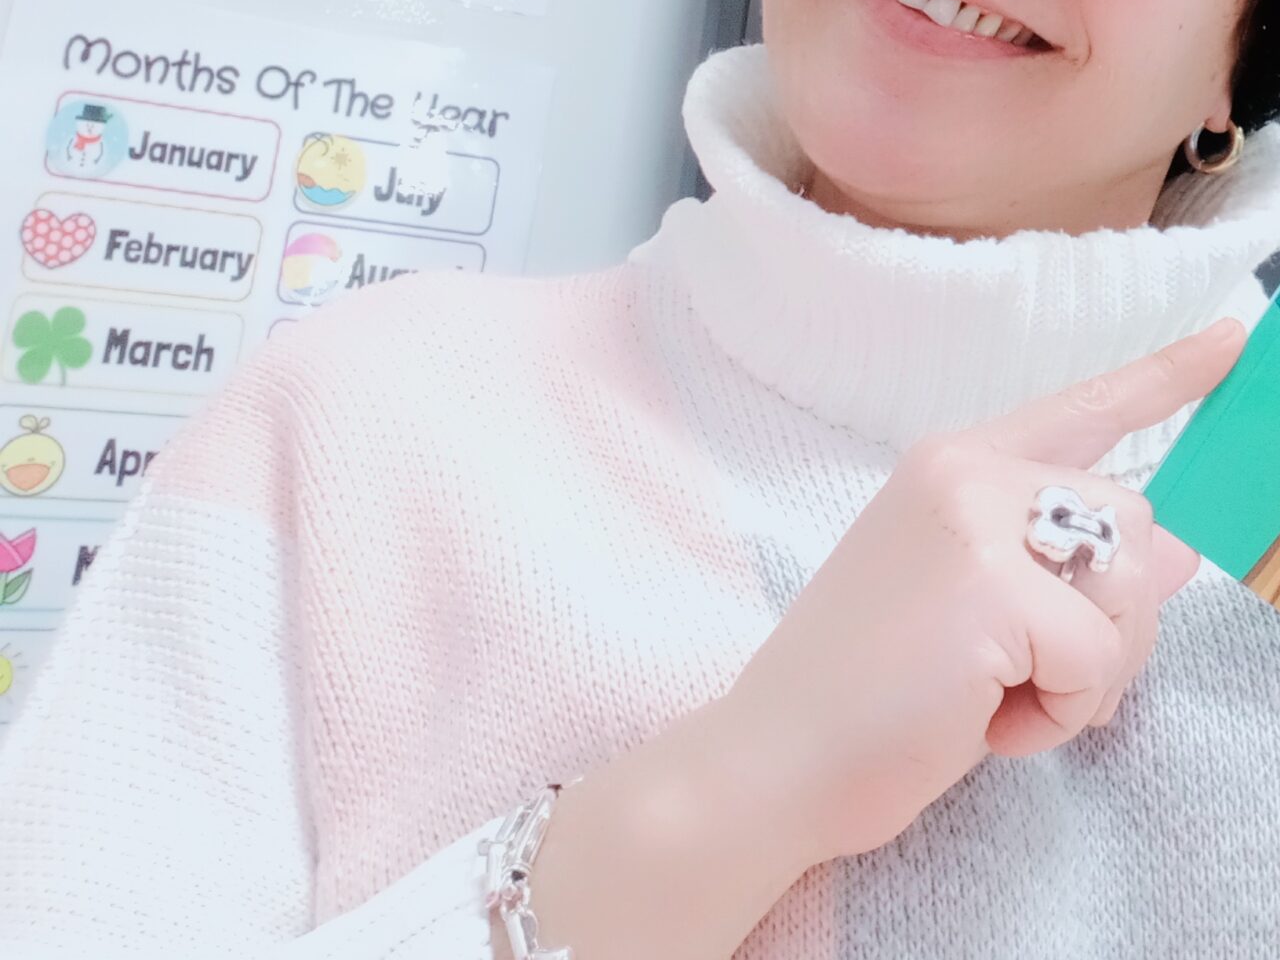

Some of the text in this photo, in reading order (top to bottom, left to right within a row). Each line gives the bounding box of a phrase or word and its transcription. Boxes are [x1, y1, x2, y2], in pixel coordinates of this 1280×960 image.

[64, 34, 240, 95] Months
[256, 65, 317, 110] Of
[323, 78, 394, 119] The
[128, 131, 257, 182] January
[104, 229, 254, 282] February
[102, 328, 215, 372] March
[94, 438, 161, 486] Apr
